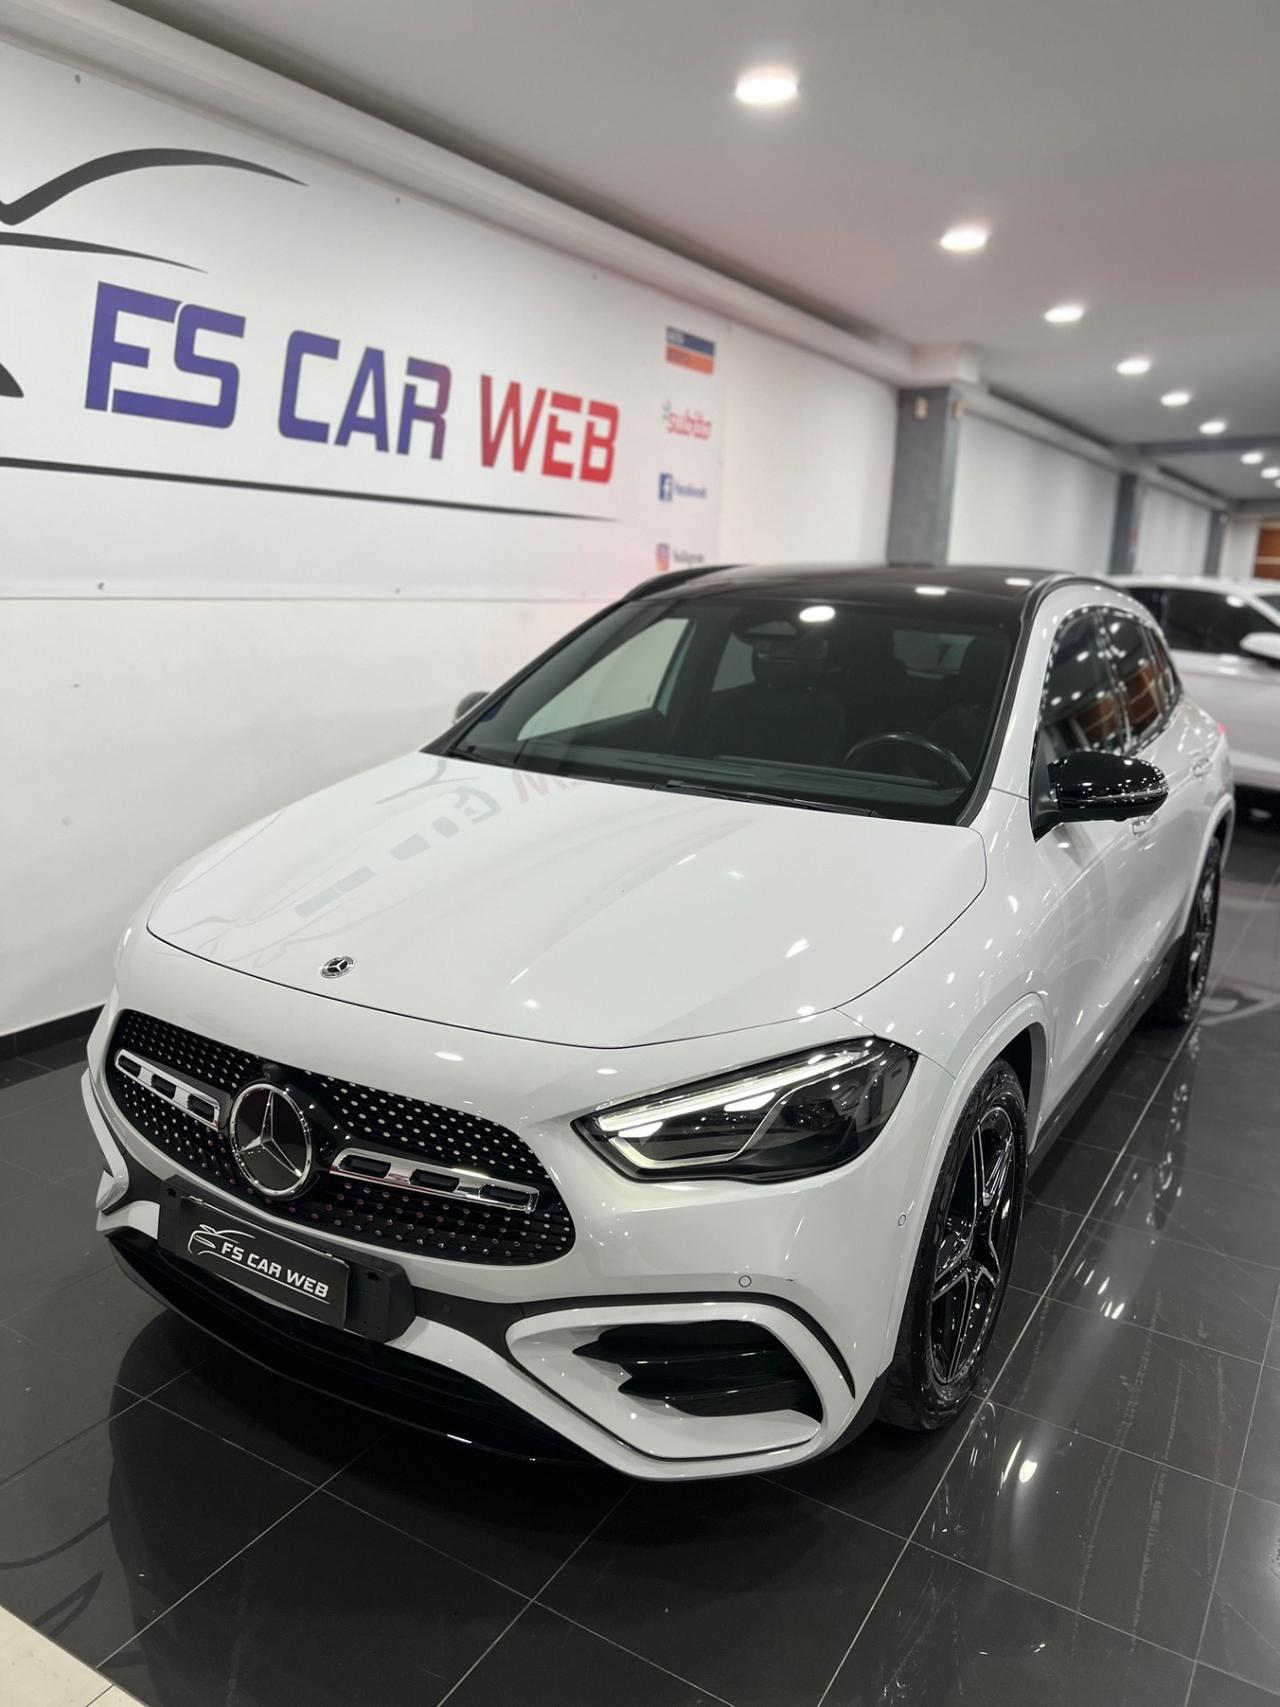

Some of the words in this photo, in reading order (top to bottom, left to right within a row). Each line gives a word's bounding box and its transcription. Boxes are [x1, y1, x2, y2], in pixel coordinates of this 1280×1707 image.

[85, 281, 246, 428] FS
[278, 330, 452, 459] CAR
[480, 374, 620, 485] WEB
[222, 1241, 244, 1261] FS
[247, 1253, 282, 1278] CAR
[287, 1269, 329, 1298] WEB
